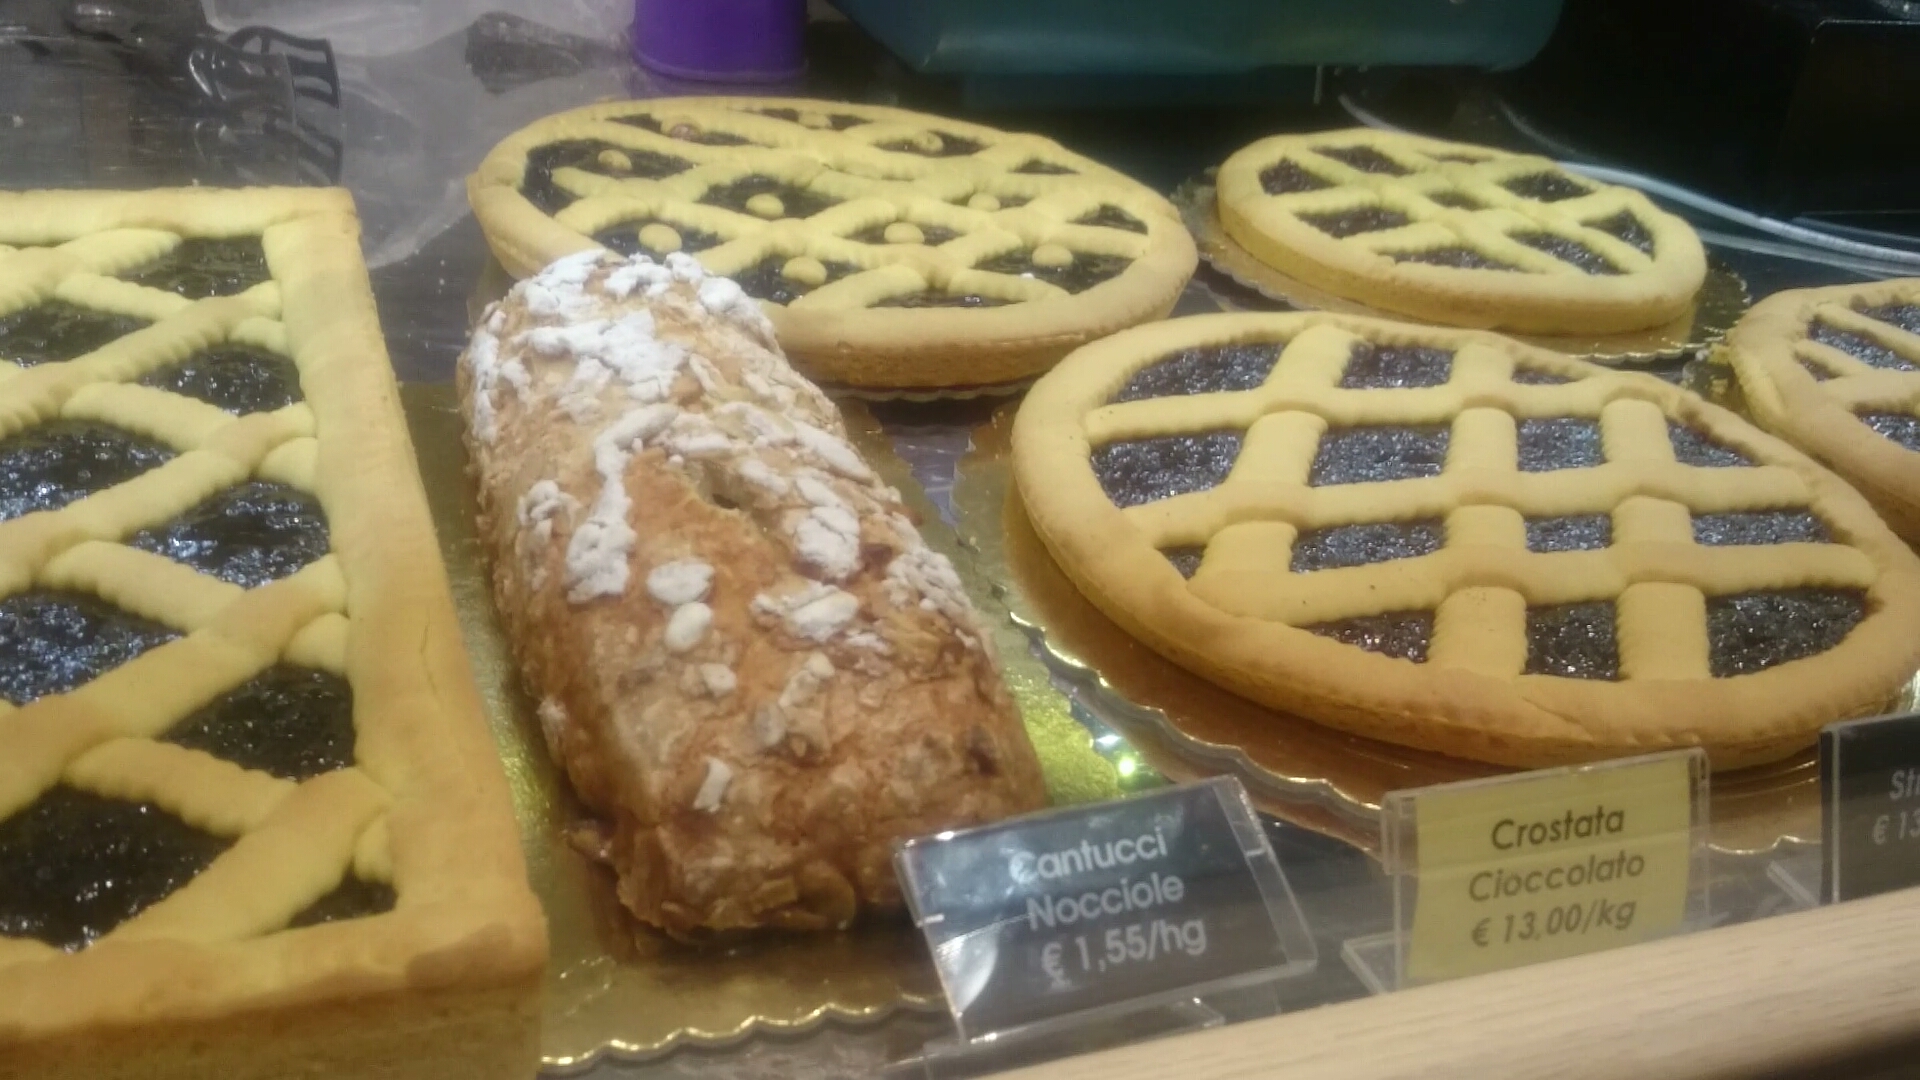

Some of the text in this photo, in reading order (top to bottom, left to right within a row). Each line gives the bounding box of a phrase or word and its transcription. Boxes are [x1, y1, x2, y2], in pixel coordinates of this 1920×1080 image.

[1491, 806, 1625, 850] Crostata
[1009, 827, 1168, 883] Cantucci
[1469, 851, 1645, 902] Cioccolato
[1026, 873, 1185, 931] Nocciole
[1041, 919, 1207, 979] € 1,55/hg
[1472, 917, 1490, 948] €
